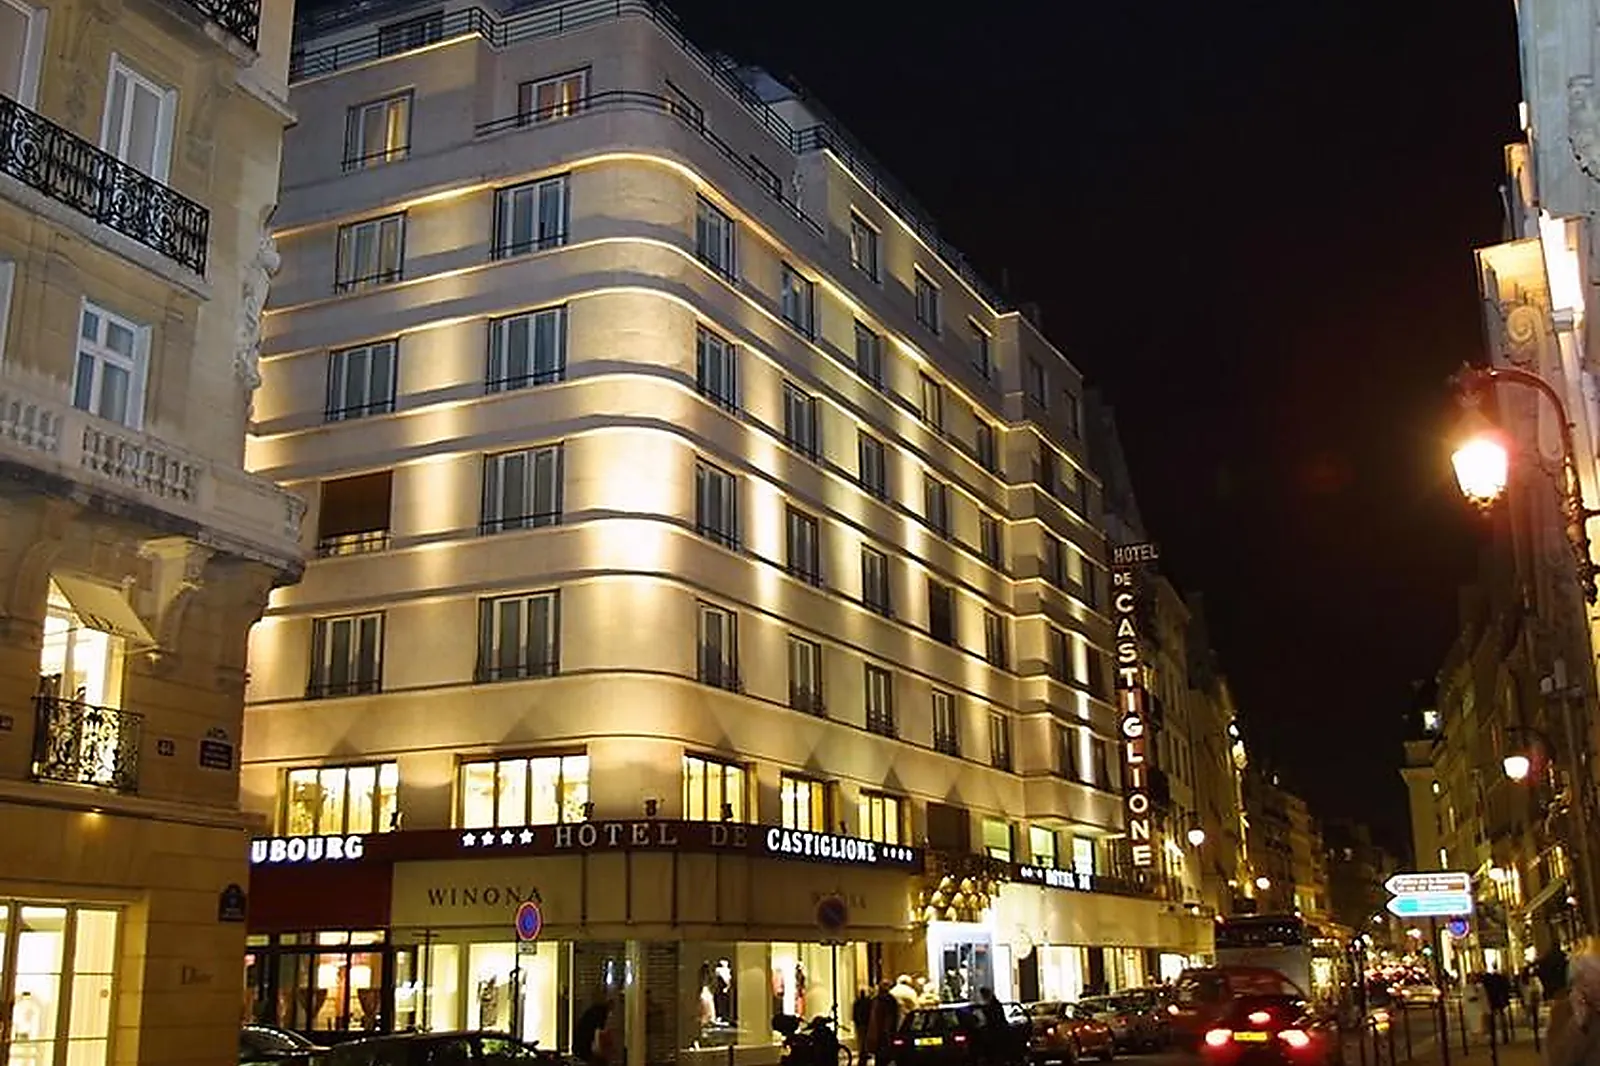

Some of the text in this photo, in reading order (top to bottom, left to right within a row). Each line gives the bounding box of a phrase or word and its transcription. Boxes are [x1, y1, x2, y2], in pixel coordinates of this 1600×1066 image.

[1114, 543, 1158, 562] HOTEL
[1114, 573, 1132, 586] DE
[1114, 593, 1153, 867] CASTIGLIONE
[252, 836, 363, 863] UBOURG
[553, 822, 877, 863] HOTEL DE CASTIGLIONE
[428, 887, 543, 906] WINONA
